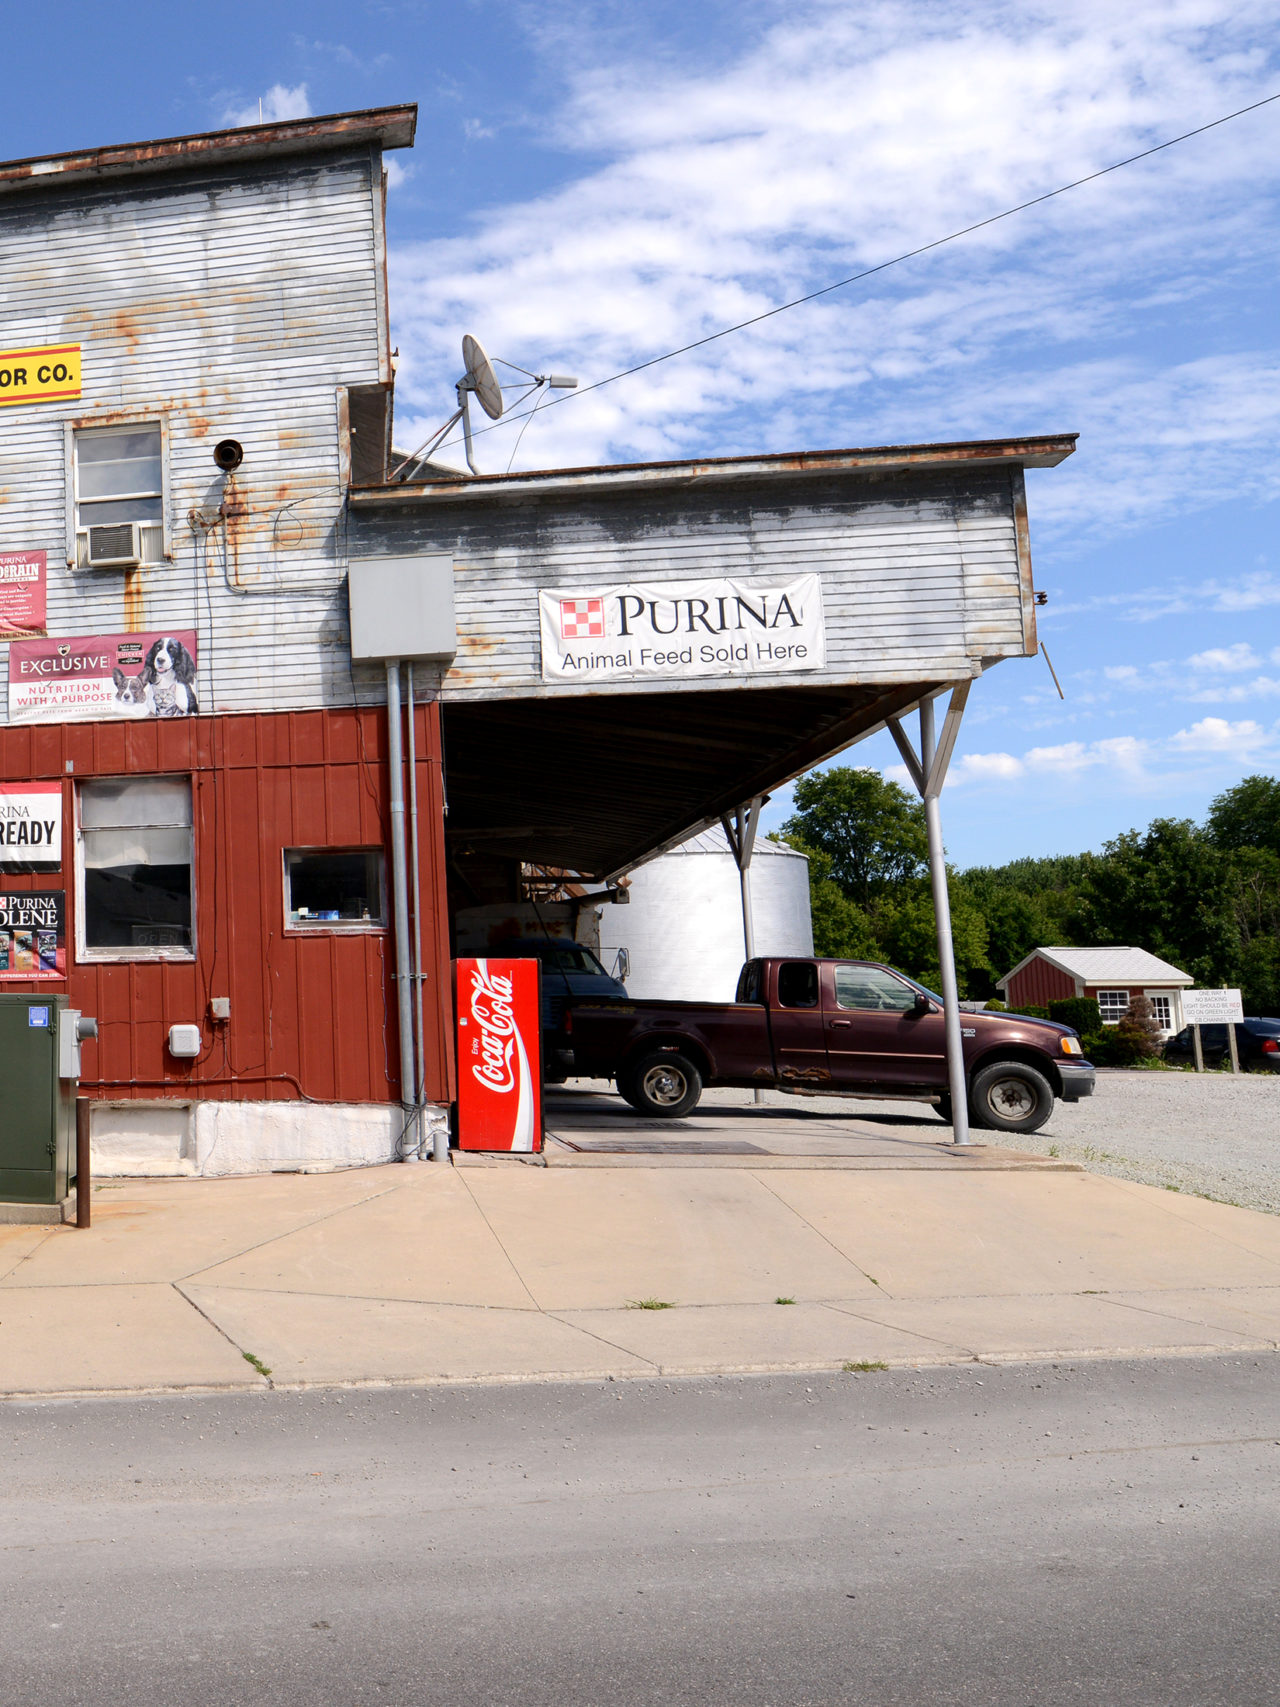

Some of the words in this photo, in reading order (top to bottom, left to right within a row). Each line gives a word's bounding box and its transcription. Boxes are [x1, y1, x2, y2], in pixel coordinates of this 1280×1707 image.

[37, 364, 73, 384] CO.
[9, 563, 39, 577] RAIN
[616, 593, 803, 635] PURINA
[562, 650, 632, 670] Animal
[640, 646, 692, 665] Feed
[700, 643, 749, 662] Sold
[756, 642, 808, 660] Here
[20, 656, 108, 676] EXCLUSIVE
[28, 683, 100, 695] NUTRITION
[17, 697, 47, 706] WITH
[51, 696, 58, 704] A
[61, 693, 112, 703] PURPOSE
[9, 897, 56, 910] PURINA
[137, 935, 177, 945] OPEN
[471, 970, 514, 1093] Coca-Cola
